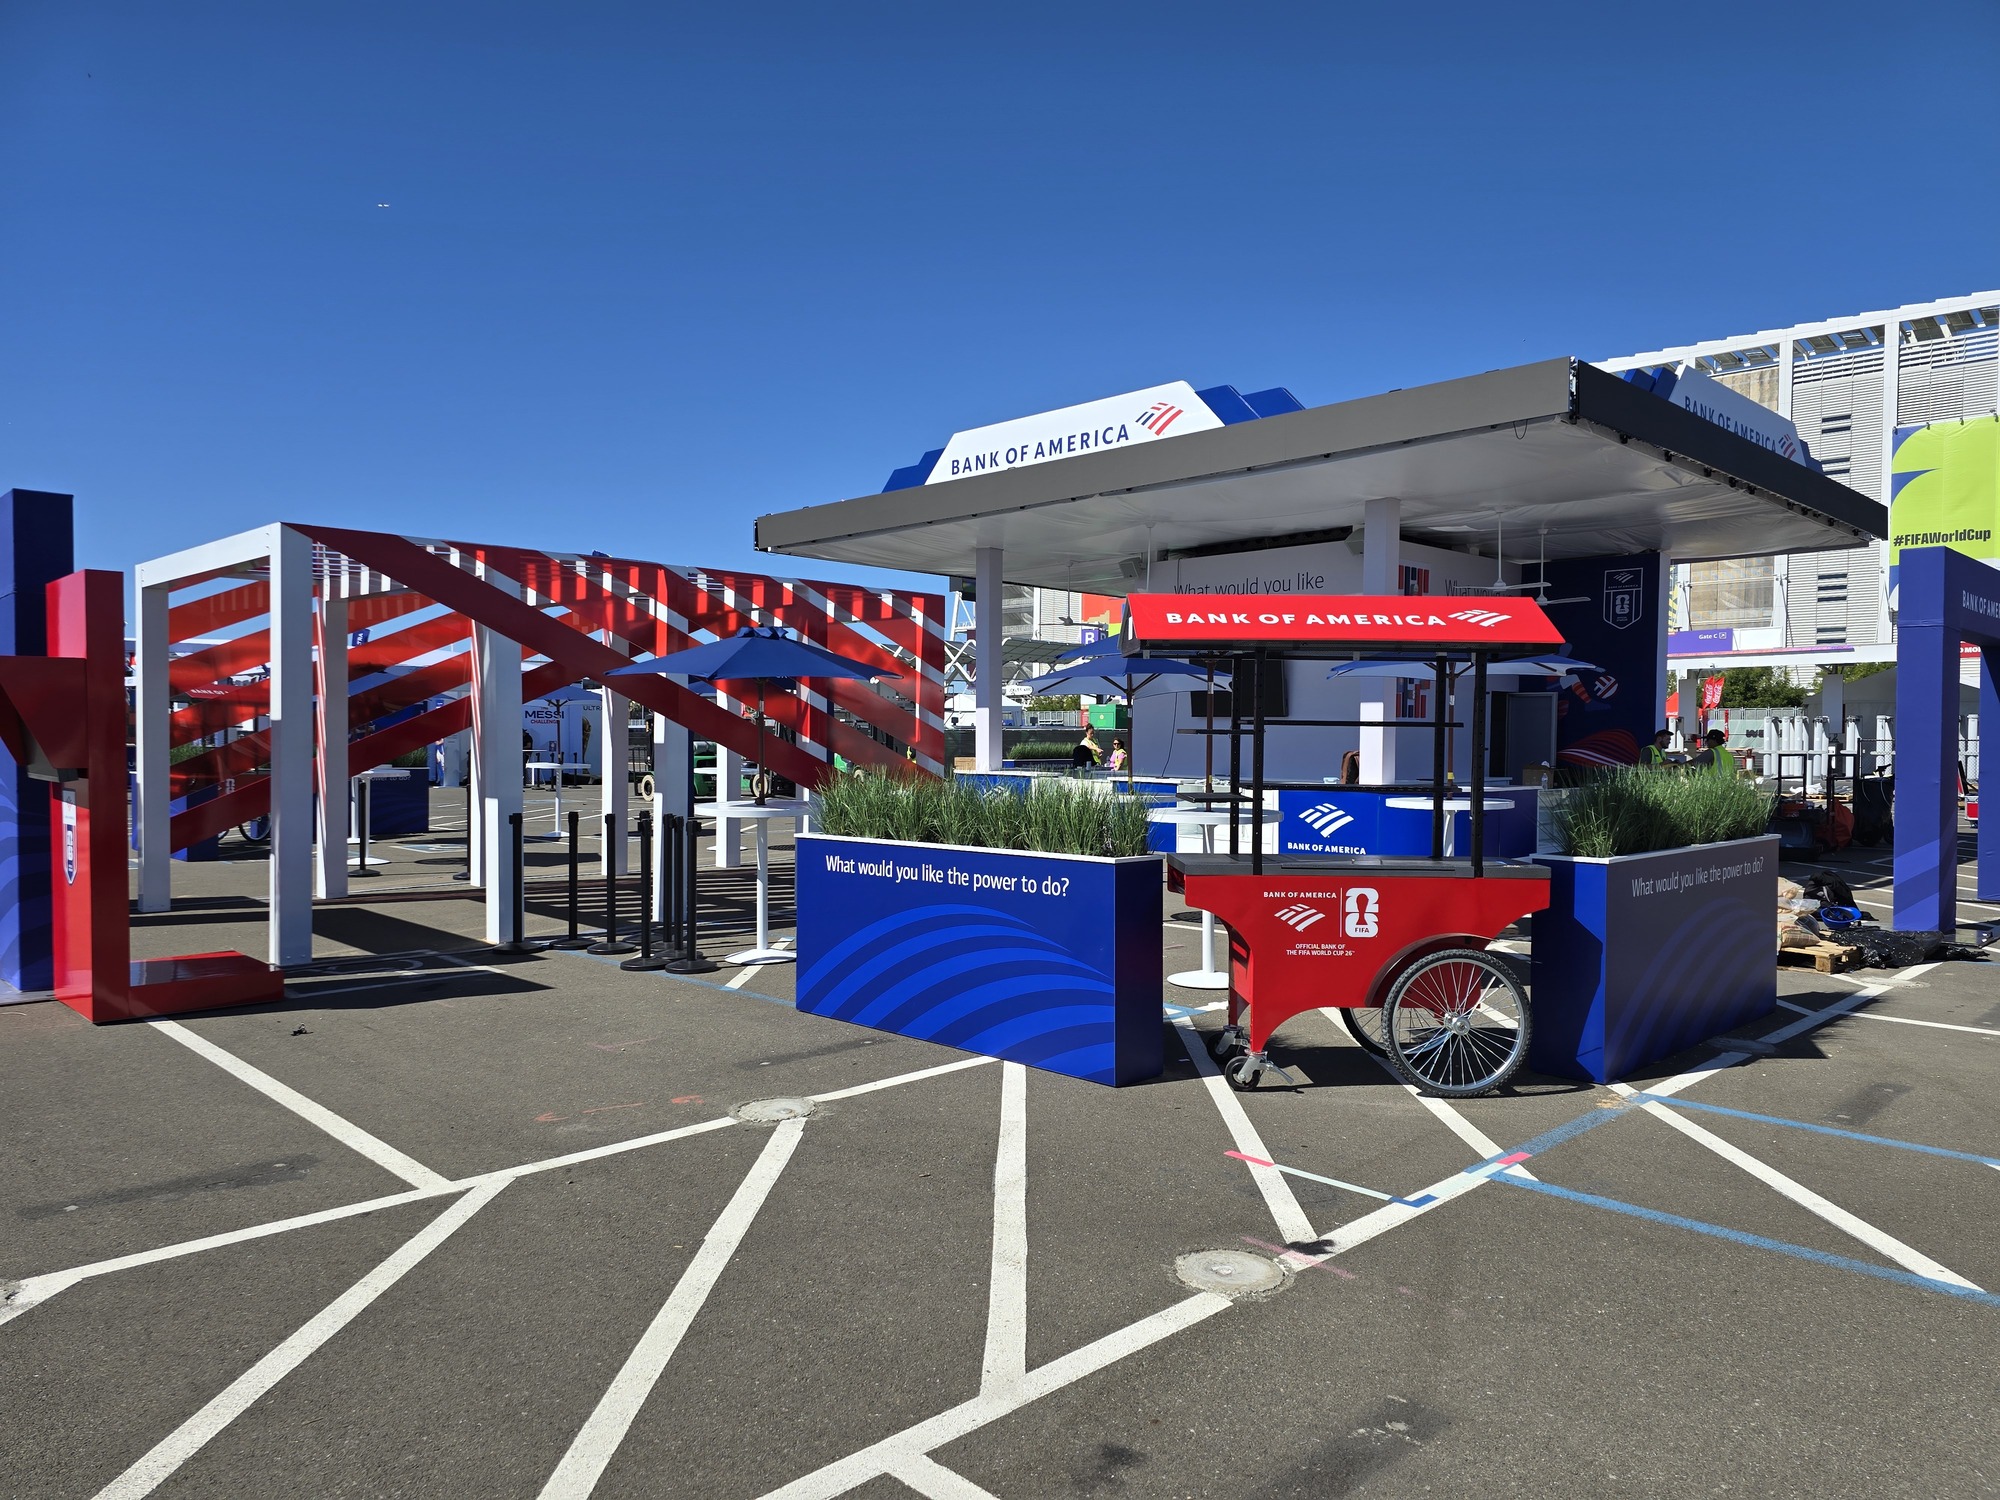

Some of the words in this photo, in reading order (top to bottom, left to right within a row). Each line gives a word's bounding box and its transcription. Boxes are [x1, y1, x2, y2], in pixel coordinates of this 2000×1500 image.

[1685, 396, 1714, 422] BANK
[1718, 413, 1731, 431] OF
[1732, 421, 1776, 451] AMERICA
[951, 450, 999, 475] BANK
[1005, 445, 1028, 464] OF
[1034, 424, 1129, 459] AMERICA
[1893, 529, 1991, 546] #FIFAWorldCup
[1215, 577, 1258, 595] would
[1264, 579, 1291, 595] you
[1297, 572, 1324, 590] like
[1962, 590, 1978, 612] BANK
[1979, 597, 1986, 614] OF
[1166, 613, 1251, 624] BANK
[1258, 613, 1295, 625] OF
[1306, 614, 1446, 626] AMERICA
[1085, 632, 1095, 644] B
[525, 711, 564, 719] MESSI
[1287, 842, 1310, 850] BANK
[1325, 845, 1366, 855] AMERICA
[825, 855, 855, 874] What
[858, 860, 893, 878] would
[895, 865, 918, 883] you
[922, 863, 944, 883] like
[947, 867, 969, 886] the
[973, 872, 1017, 891] power
[1021, 875, 1037, 893] to
[1042, 876, 1070, 897] do?
[1631, 878, 1653, 897] What
[1655, 872, 1679, 893] would
[1680, 875, 1694, 893] you
[1695, 867, 1708, 885] like
[1710, 865, 1721, 882] the
[1722, 863, 1743, 884] power
[1744, 861, 1751, 875] to
[1752, 856, 1764, 873] do?
